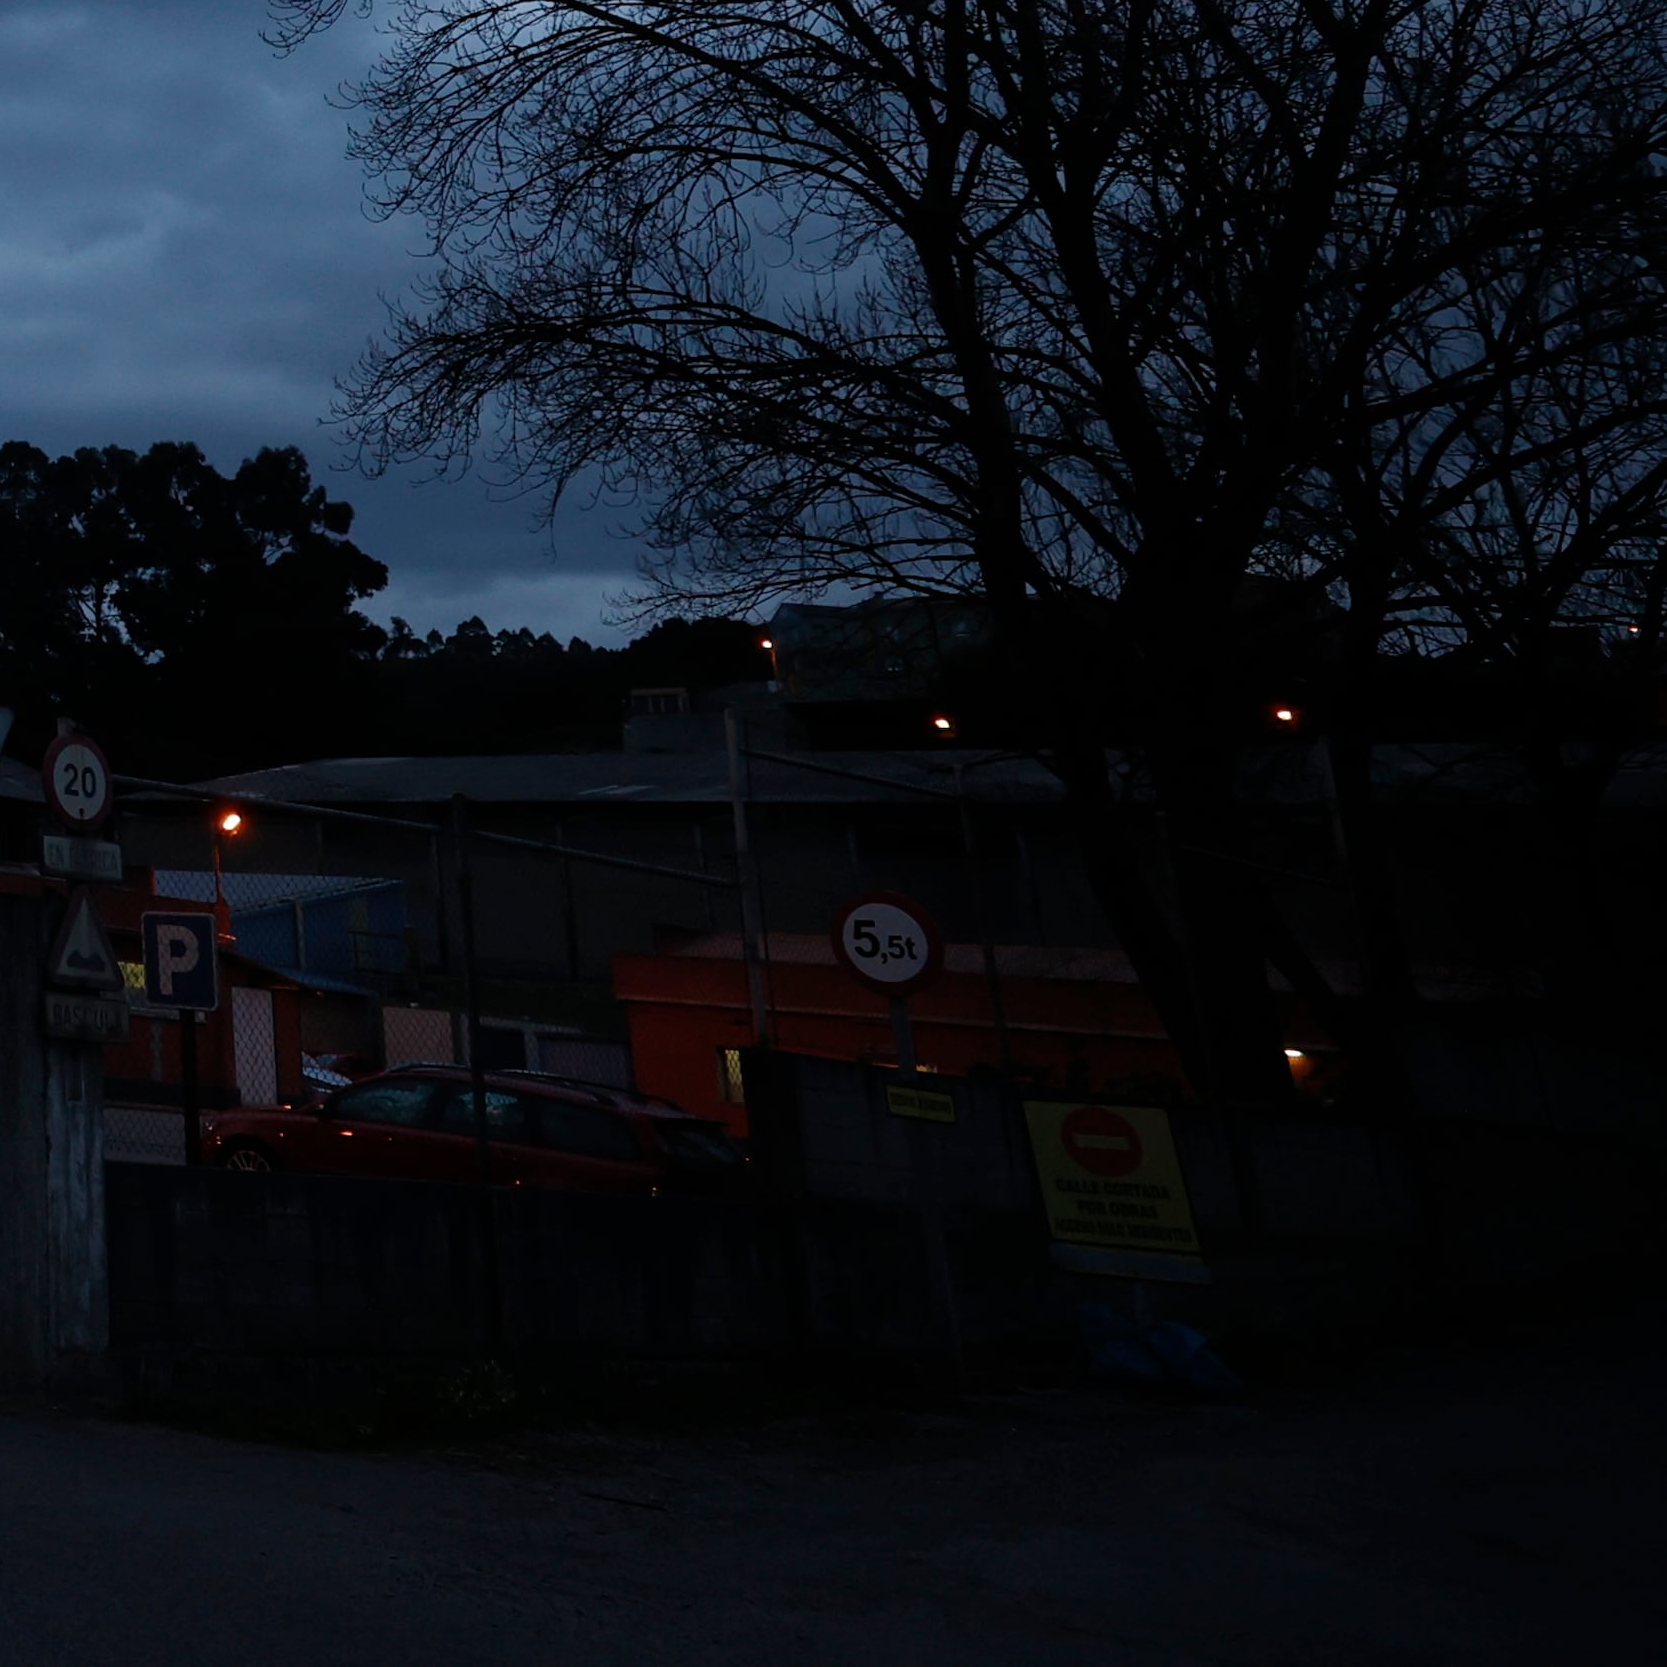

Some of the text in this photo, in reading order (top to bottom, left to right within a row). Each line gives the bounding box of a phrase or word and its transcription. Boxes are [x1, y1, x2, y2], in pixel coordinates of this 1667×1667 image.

[64, 763, 96, 798] 20
[156, 924, 200, 996] P
[853, 920, 917, 964] 5,5t
